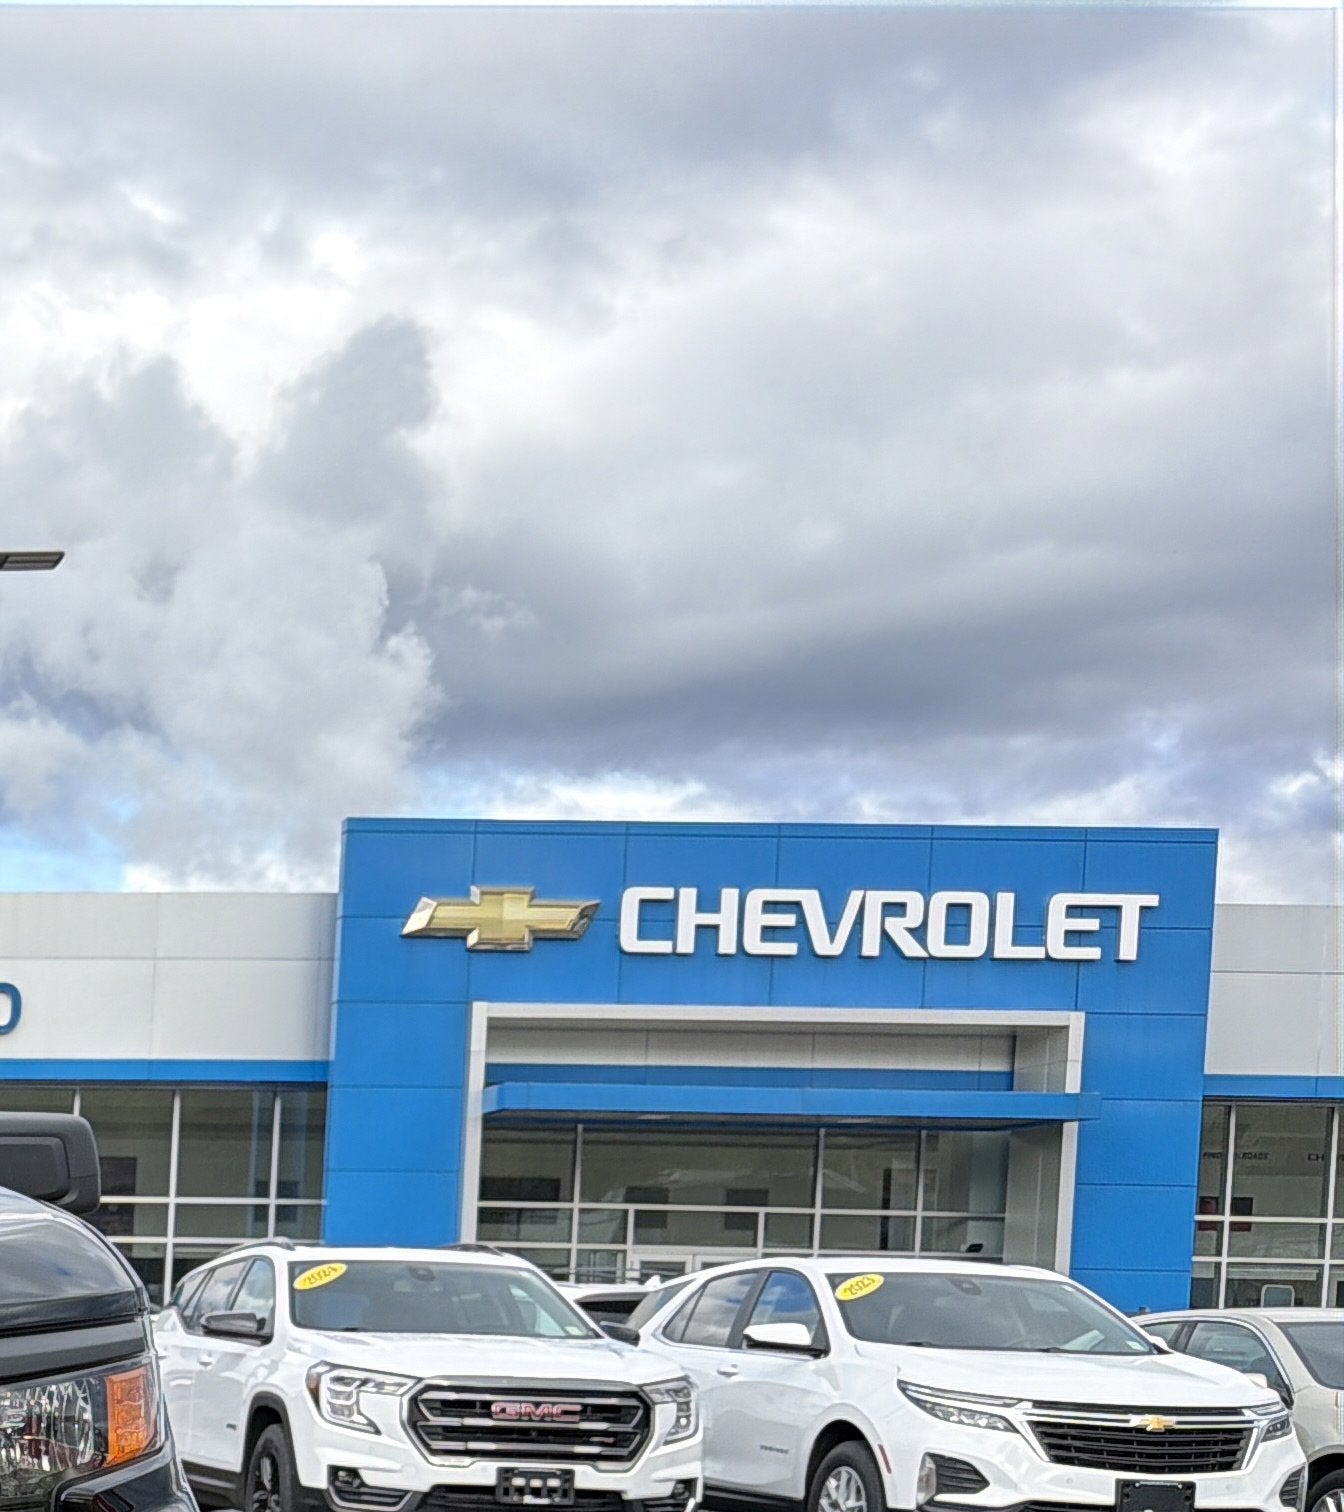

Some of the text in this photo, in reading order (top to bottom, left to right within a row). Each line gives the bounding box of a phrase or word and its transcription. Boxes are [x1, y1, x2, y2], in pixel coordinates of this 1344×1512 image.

[619, 886, 1160, 961] CHEVROLET
[843, 1276, 876, 1296] 2023
[491, 1401, 583, 1422] GMC
